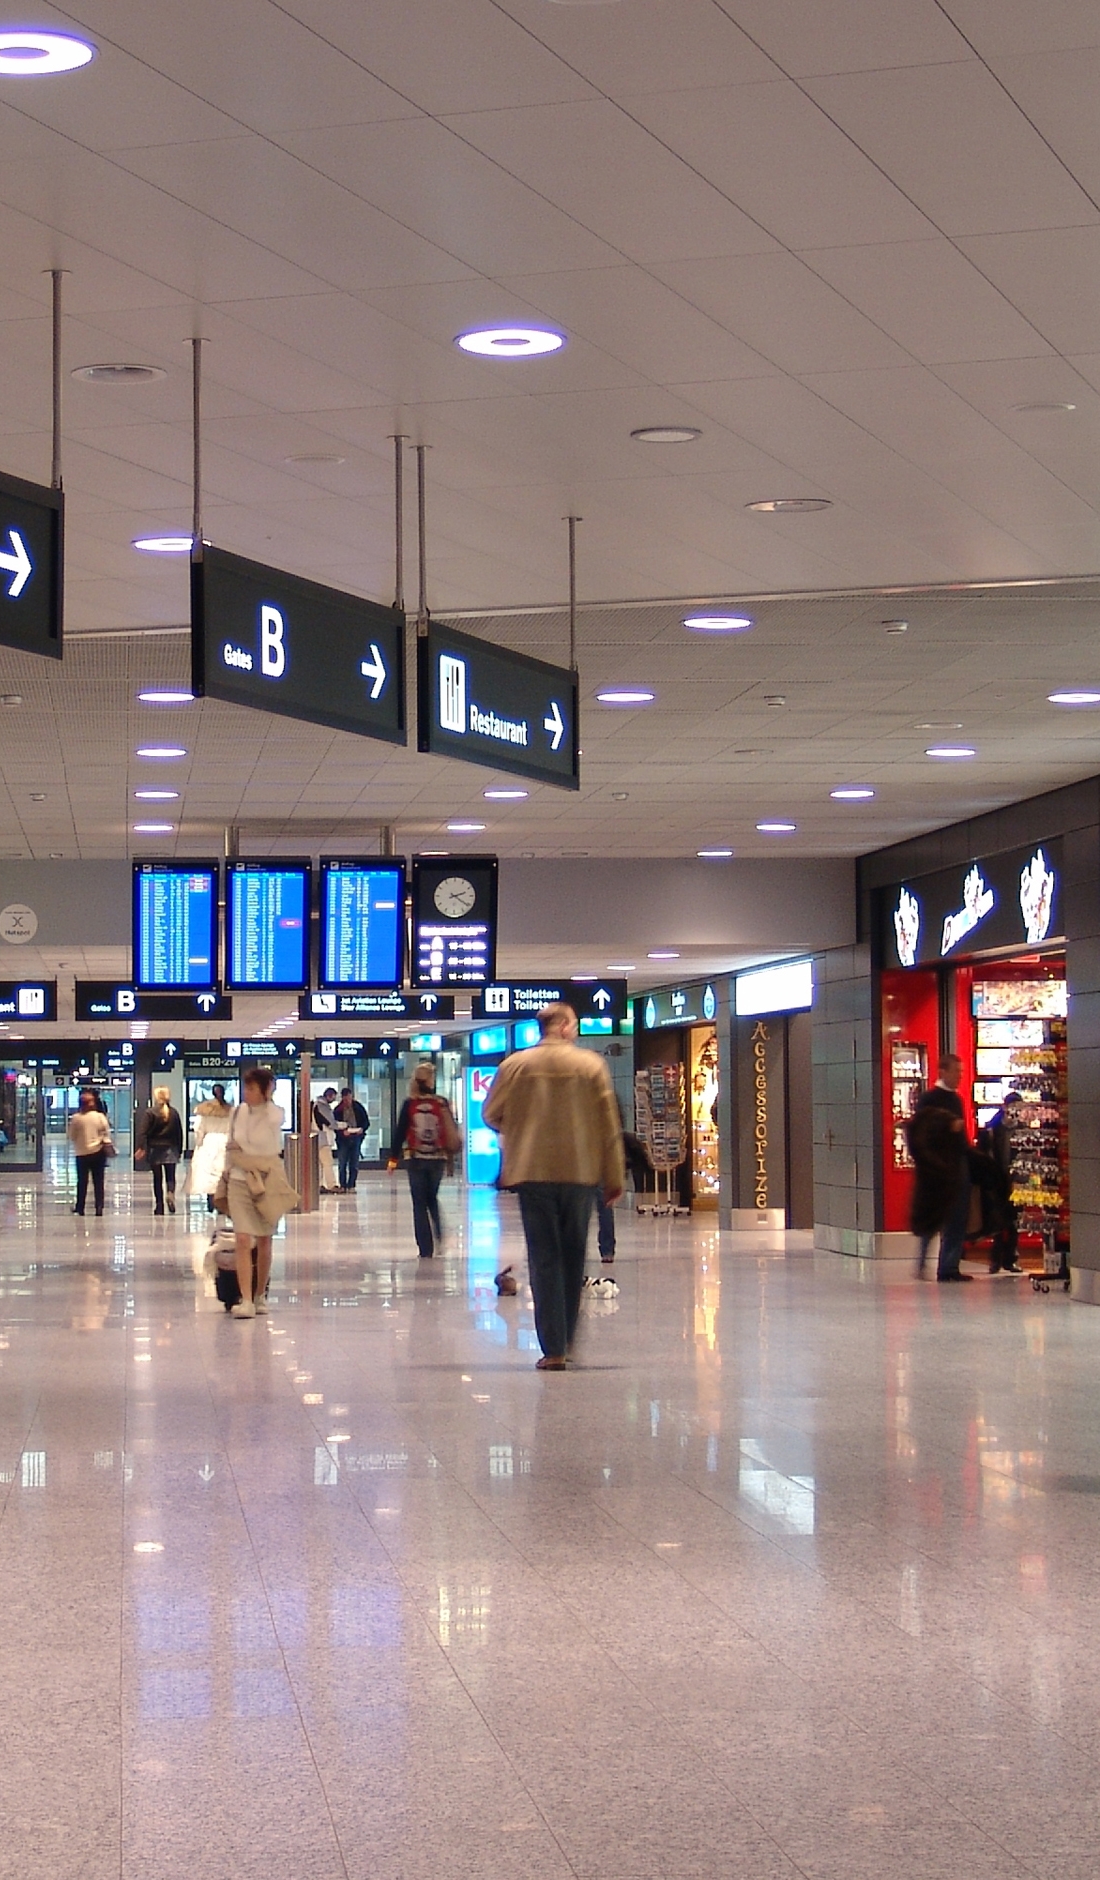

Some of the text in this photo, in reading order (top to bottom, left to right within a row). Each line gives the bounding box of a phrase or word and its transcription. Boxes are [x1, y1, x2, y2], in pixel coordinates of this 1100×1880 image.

[223, 604, 285, 678] Gates B
[469, 703, 528, 746] Restaurant
[117, 990, 136, 1012] B
[513, 988, 560, 1000] Toiletten
[513, 1000, 549, 1011] Toilets
[122, 1043, 134, 1056] B
